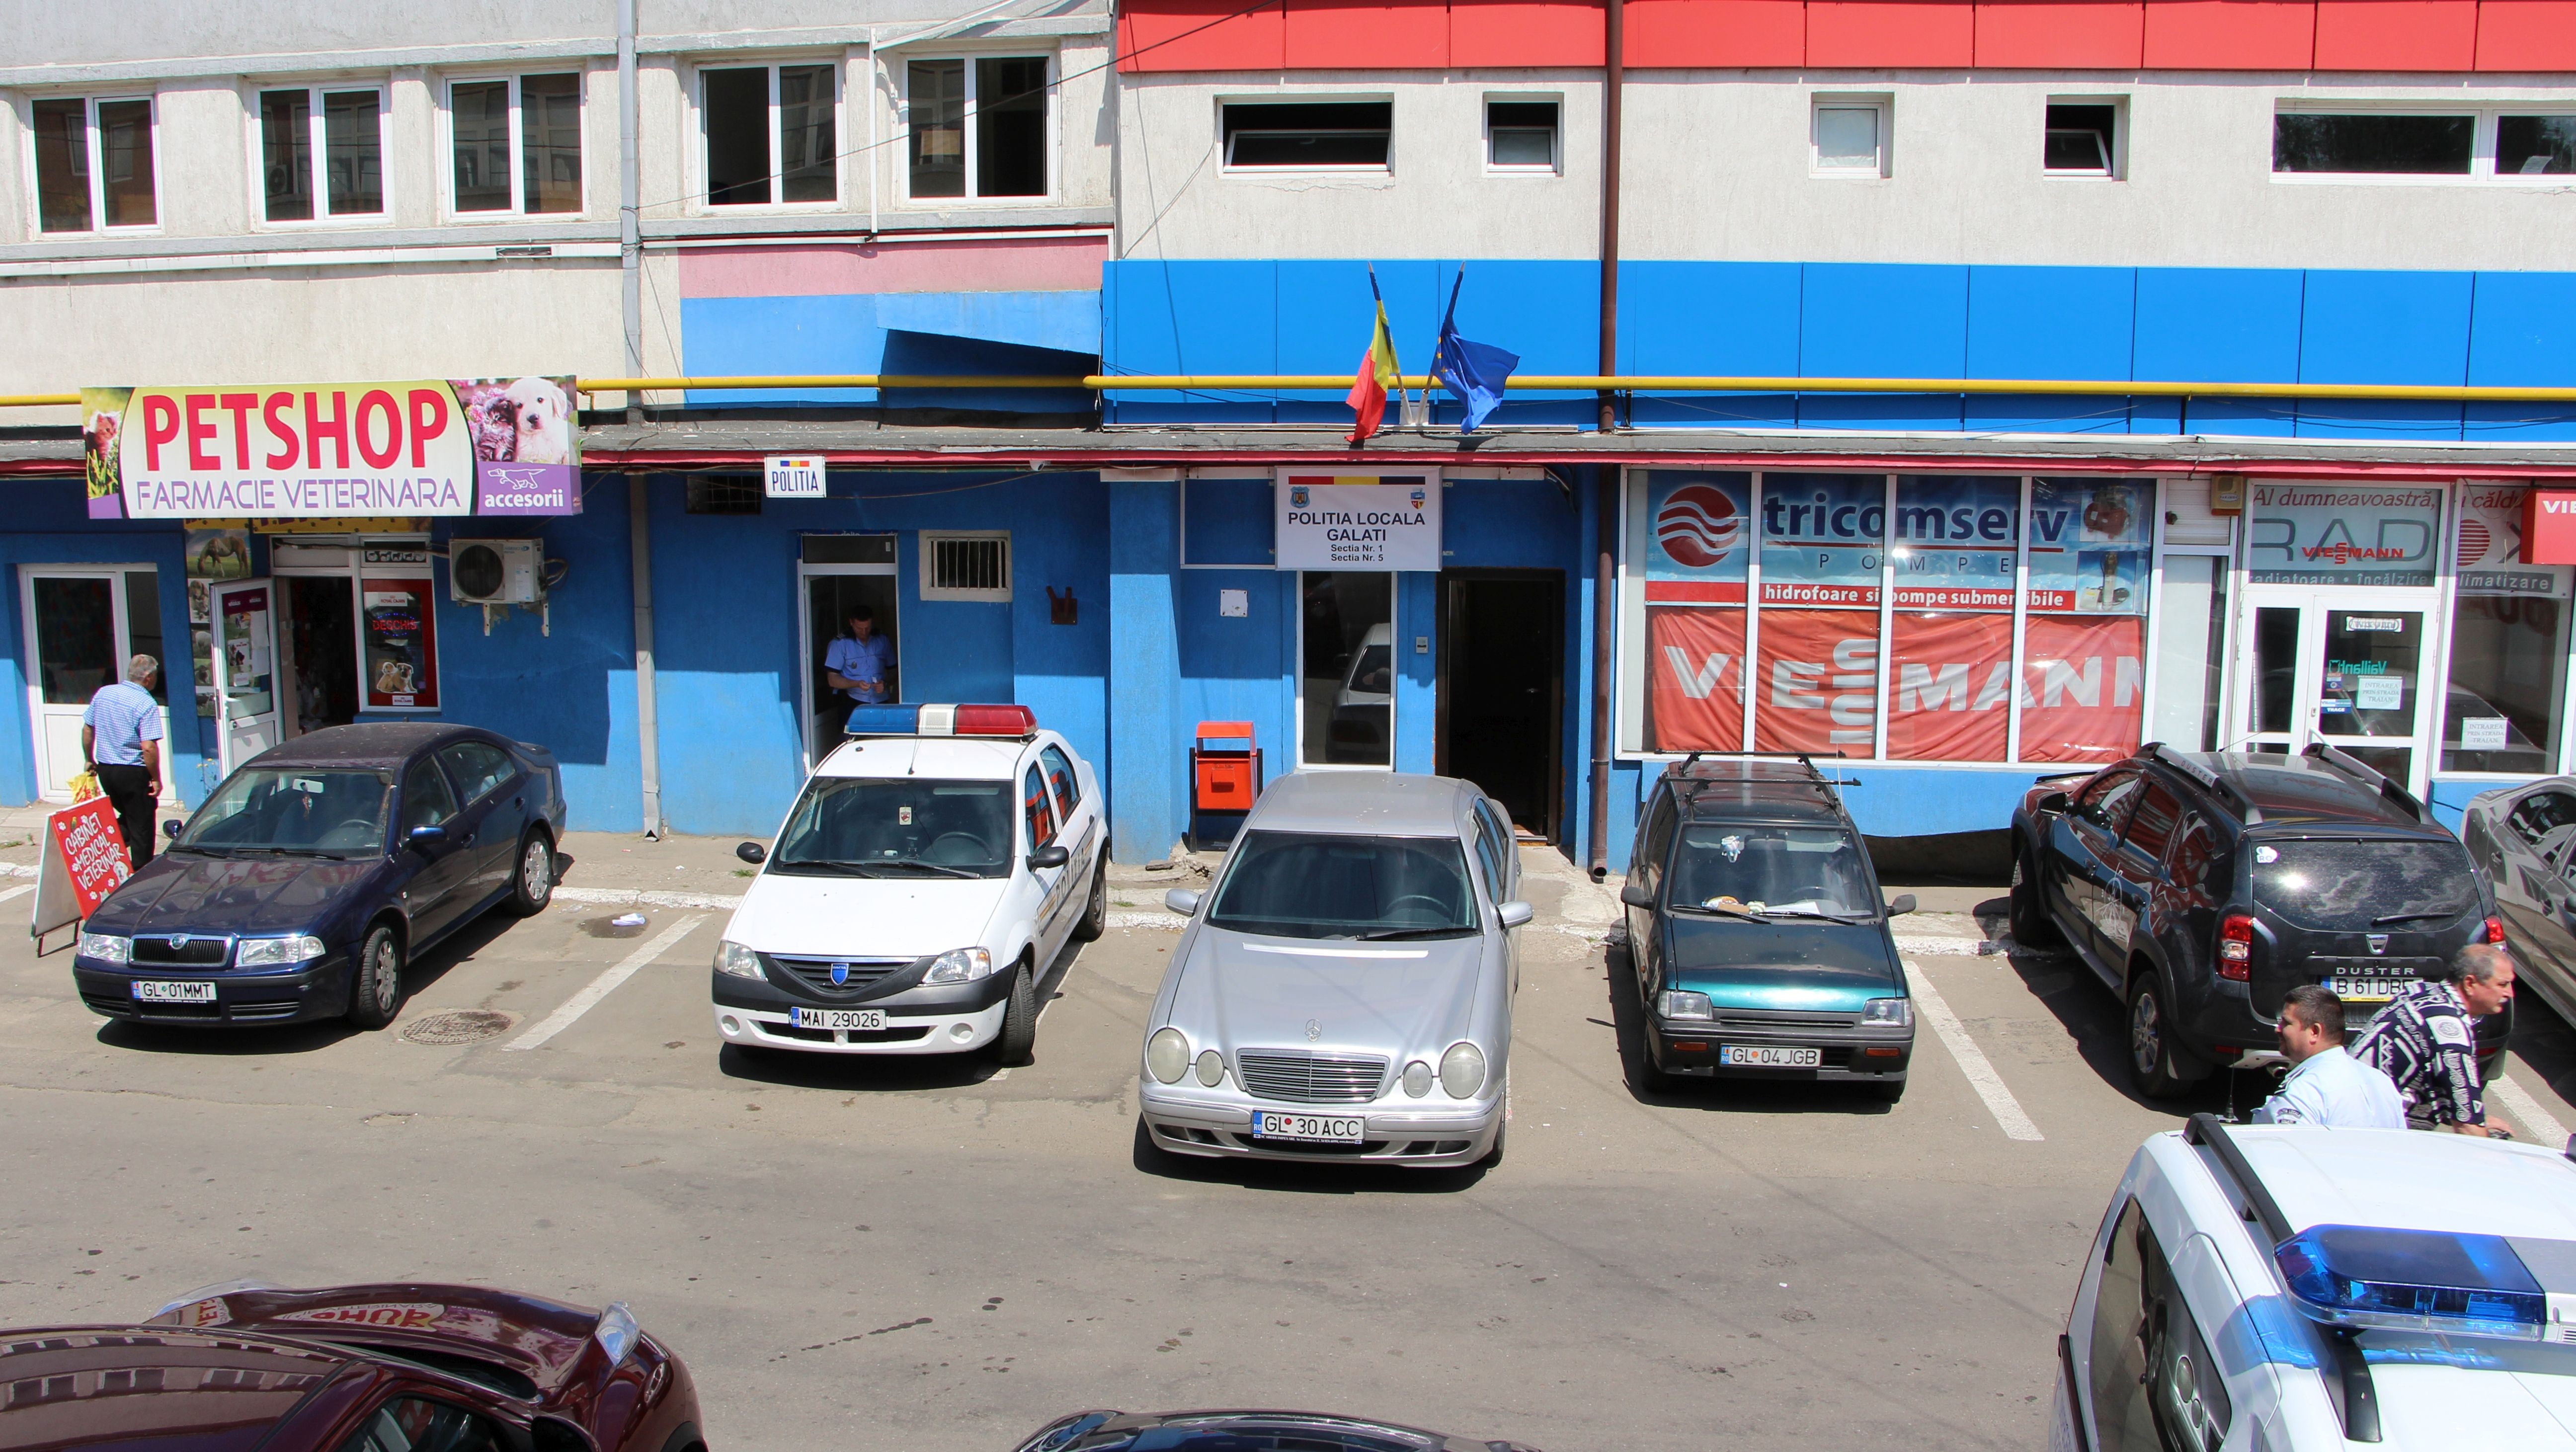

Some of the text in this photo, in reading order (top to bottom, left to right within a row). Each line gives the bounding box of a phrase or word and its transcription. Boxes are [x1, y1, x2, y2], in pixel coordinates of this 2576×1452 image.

[142, 390, 448, 471] PETSHOP
[772, 471, 819, 491] POLITIA
[136, 477, 461, 510] FARMACIE VETERINARA
[484, 489, 564, 507] accesorii
[2253, 487, 2435, 510] Al dumneavoastră,
[1288, 512, 1426, 525] POLITIA LOCALA
[1327, 529, 1386, 541] GALATI
[1820, 554, 2009, 572] POMPE
[2459, 574, 2549, 590] limatizare
[1765, 584, 1858, 602] hidrofoare
[1865, 587, 1879, 602] si
[1951, 590, 2063, 606] submeribile
[373, 620, 417, 630] DESCHIS
[2181, 760, 2213, 785] DUSTER
[65, 812, 102, 855] CABINET
[75, 832, 110, 871] MEDICAL
[78, 843, 125, 890] VETERINAR
[143, 983, 161, 997] GL
[2336, 978, 2348, 994] B
[2355, 978, 2370, 994] 61
[801, 1011, 824, 1026] MAI
[832, 1012, 880, 1027] 29026
[1733, 1049, 1753, 1062] GL
[1761, 1049, 1780, 1063] 04
[1784, 1050, 1817, 1064] JGB
[1265, 1116, 1288, 1133] GL
[1296, 1118, 1317, 1135] 30
[1321, 1120, 1359, 1136] ACC
